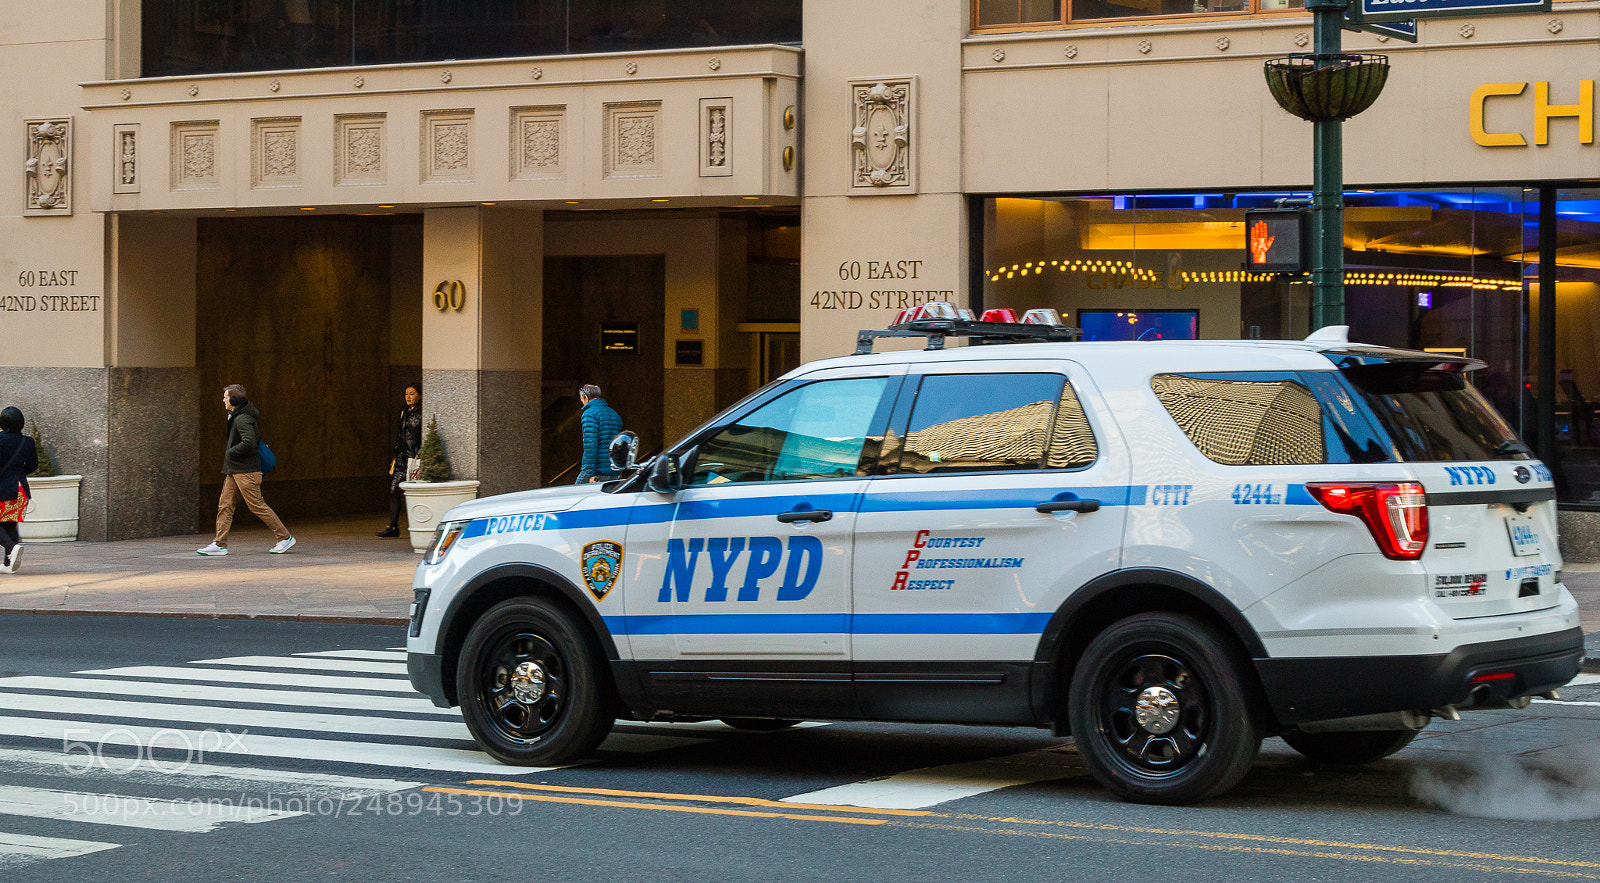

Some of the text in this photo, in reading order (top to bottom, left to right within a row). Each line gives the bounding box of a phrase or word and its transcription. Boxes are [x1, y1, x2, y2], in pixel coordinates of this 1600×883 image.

[1469, 80, 1600, 147] CH
[18, 270, 79, 287] 60 EAST
[839, 260, 923, 280] 60 EAST
[0, 295, 100, 311] 42ND STREET
[432, 280, 466, 312] 60
[810, 291, 863, 310] 42ND
[1444, 466, 1496, 486] NYPD
[1153, 485, 1193, 505] CTTF
[486, 513, 545, 536] POLICE
[913, 529, 986, 548] COURTESY
[657, 535, 823, 602] NYPD
[901, 550, 1025, 569] PROFESSIONALISM
[890, 571, 956, 591] RESPECT
